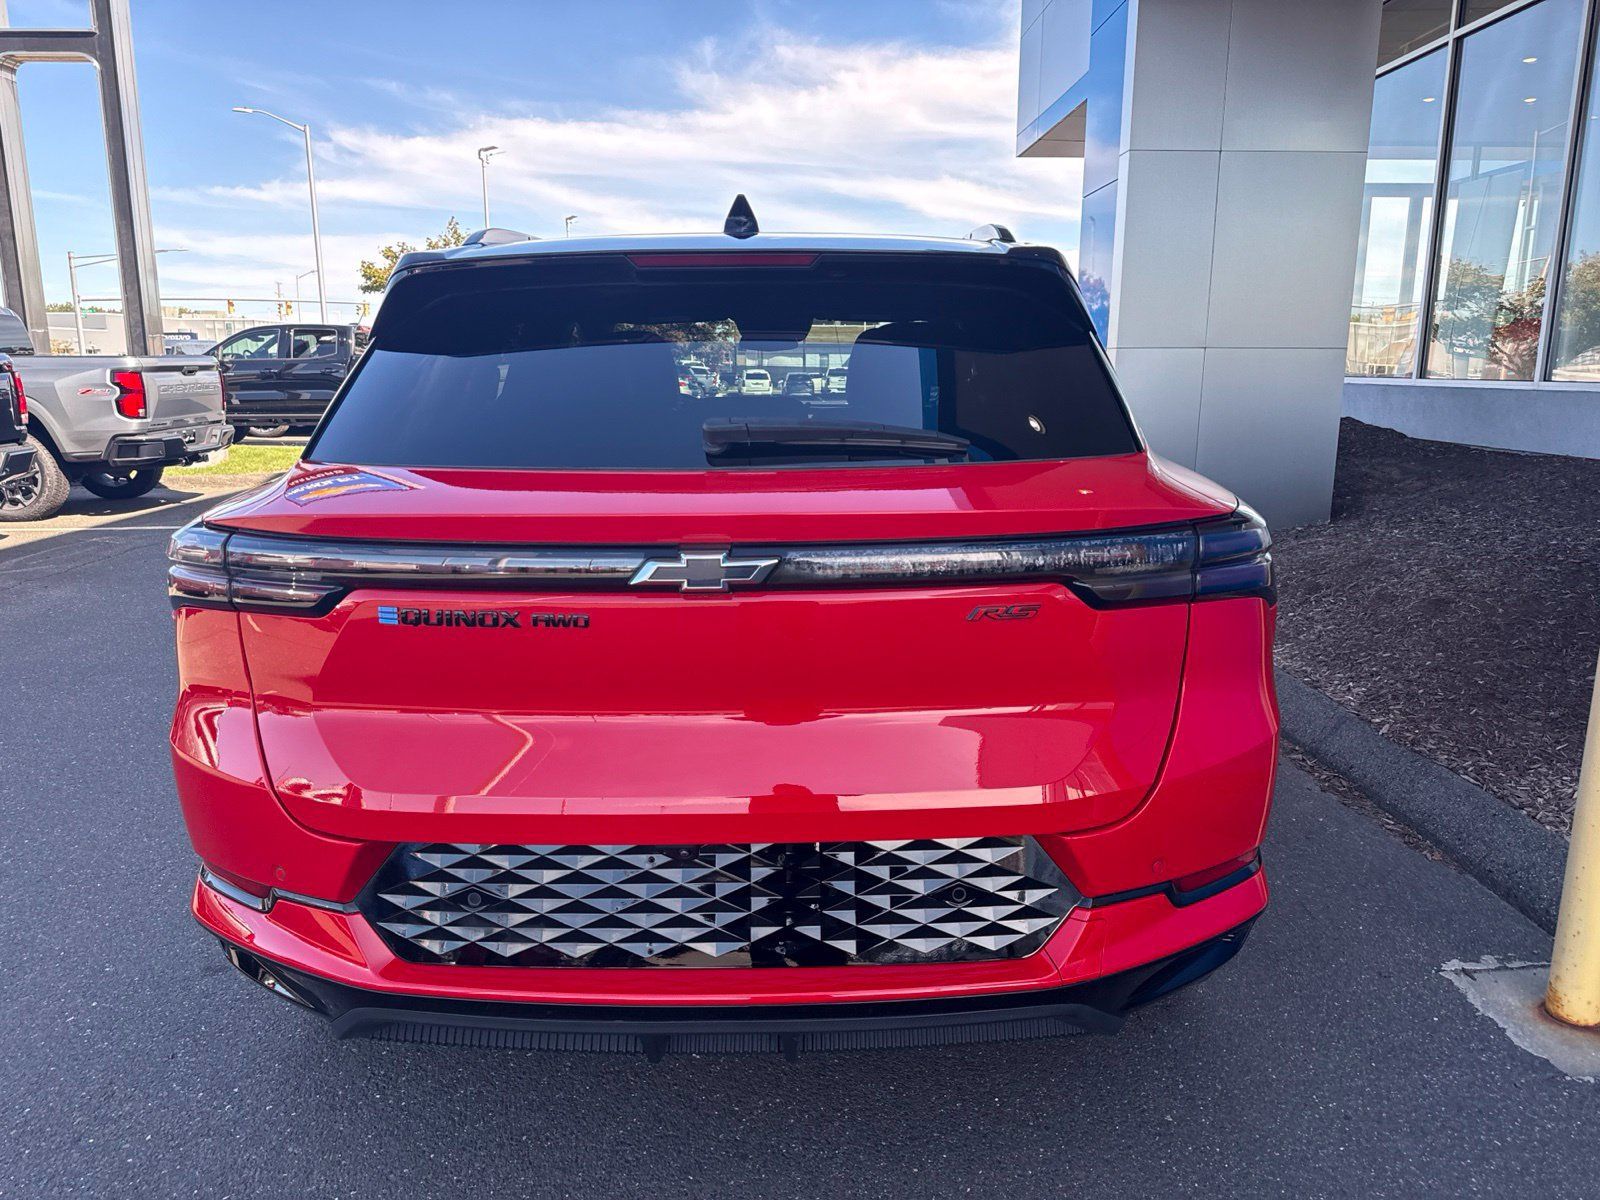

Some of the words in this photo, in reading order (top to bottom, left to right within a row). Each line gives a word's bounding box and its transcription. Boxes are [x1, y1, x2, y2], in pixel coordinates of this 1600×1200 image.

[378, 606, 521, 628] EQUINOX
[530, 613, 590, 629] AWD
[966, 604, 1041, 620] RS
